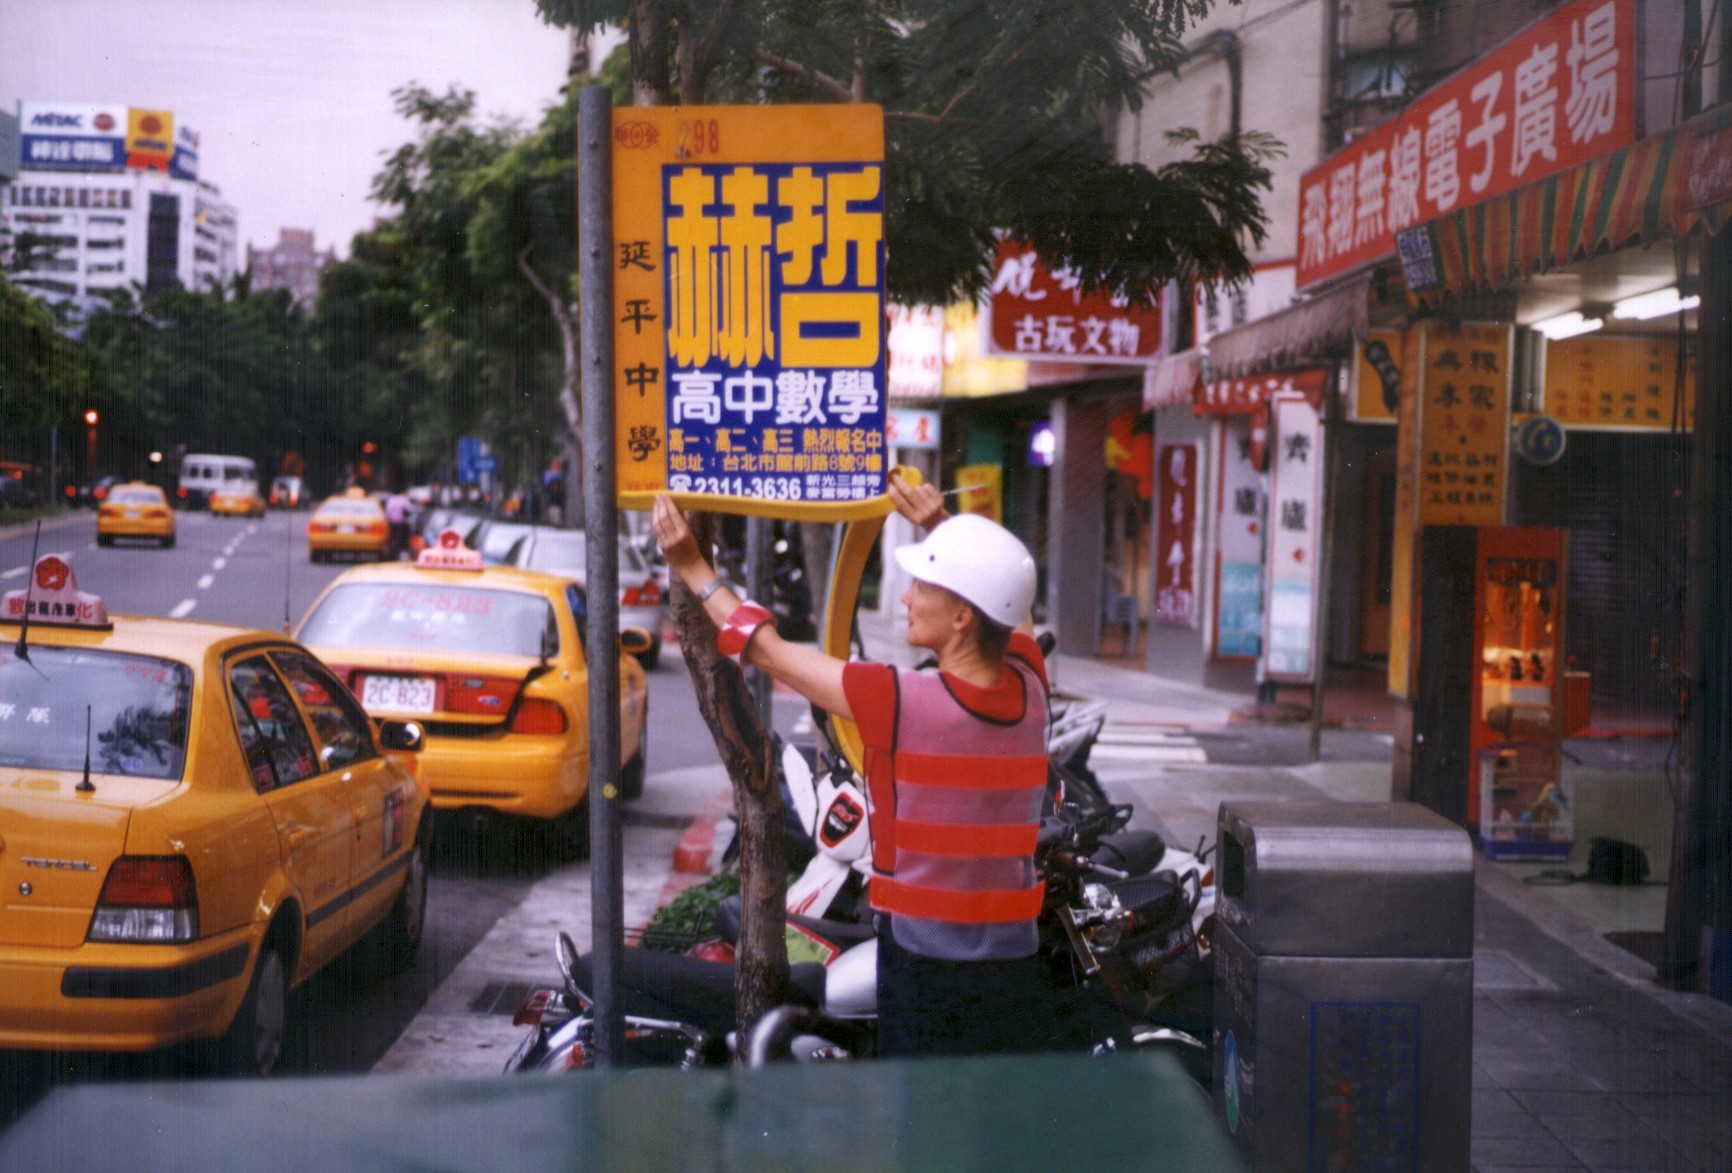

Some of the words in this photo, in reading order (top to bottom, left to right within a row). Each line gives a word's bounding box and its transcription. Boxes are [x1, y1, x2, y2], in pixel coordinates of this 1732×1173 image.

[619, 241, 661, 462] 延平中學
[1013, 313, 1140, 356] 古玩文物
[671, 370, 879, 424] 高中數學
[694, 477, 802, 500] 2311-3636
